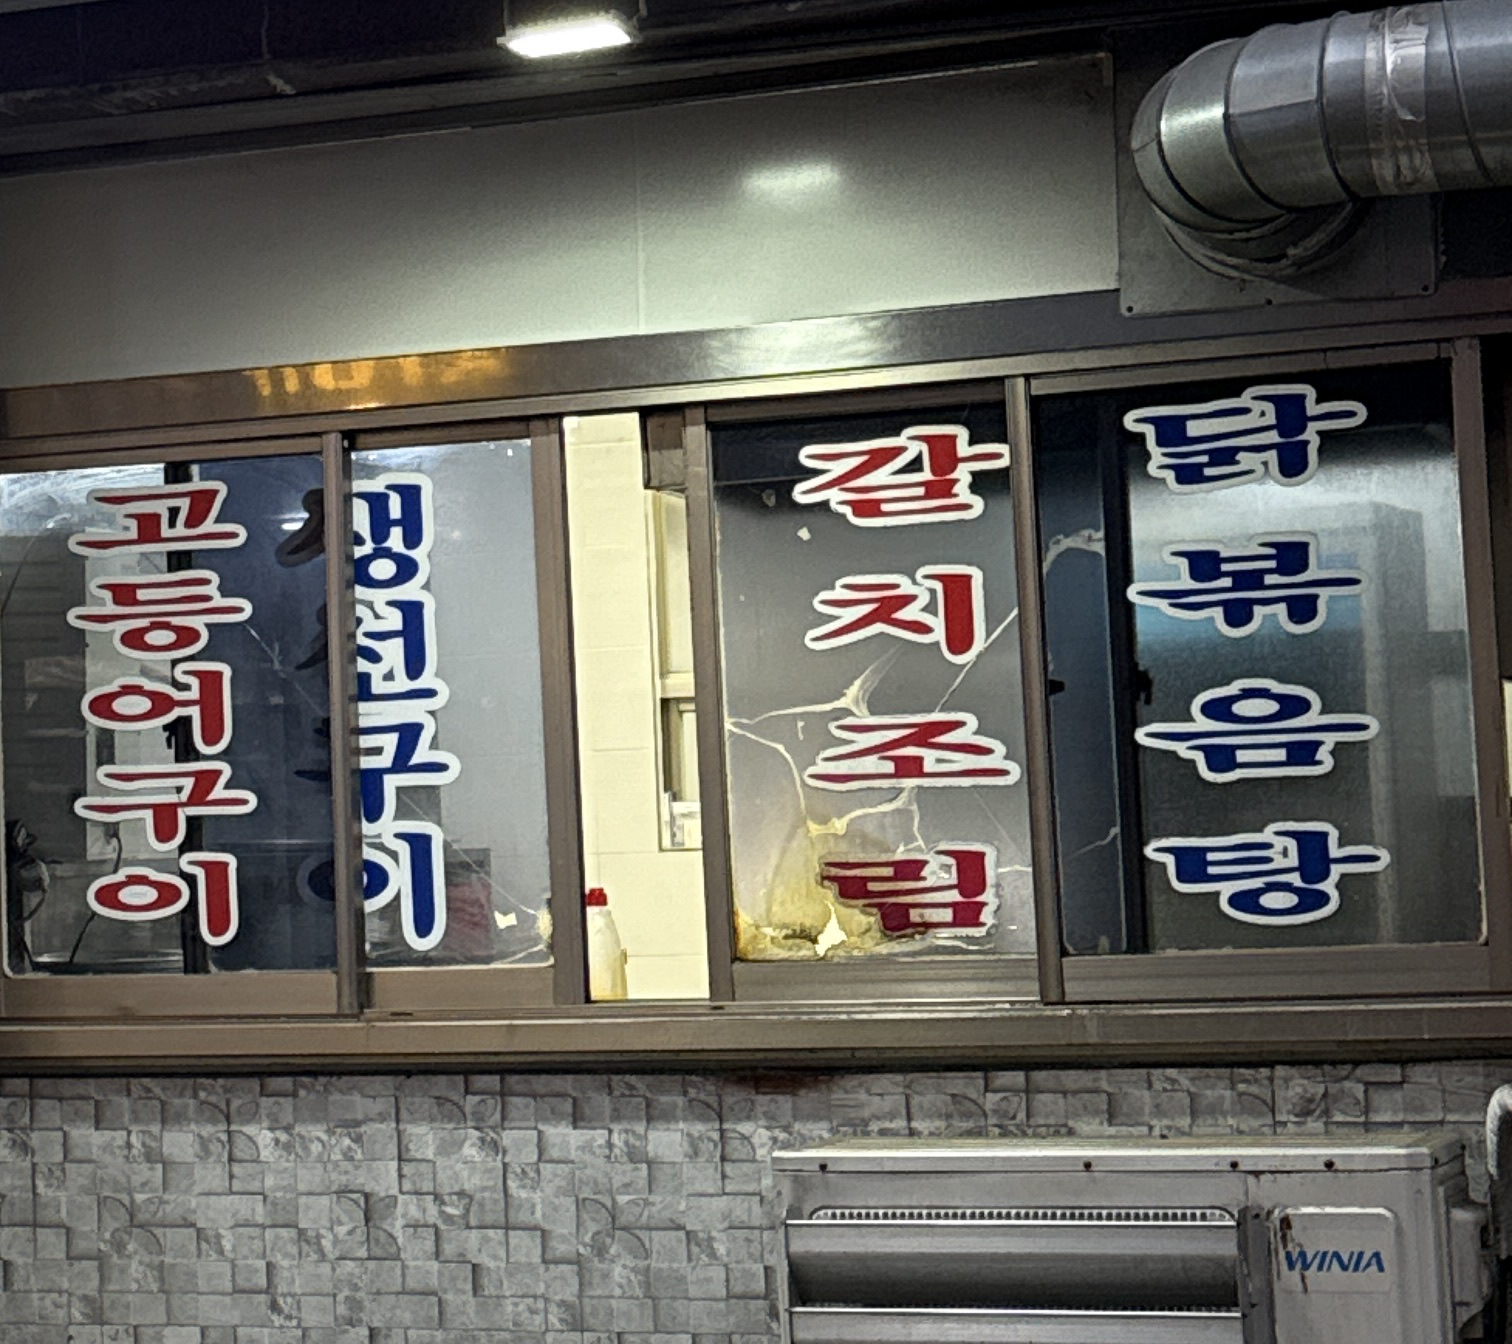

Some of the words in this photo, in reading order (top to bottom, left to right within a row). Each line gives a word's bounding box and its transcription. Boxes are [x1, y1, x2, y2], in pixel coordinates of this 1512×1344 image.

[72, 486, 253, 941] 고등어구이
[799, 431, 1012, 934] 갈치조림
[1130, 390, 1387, 918] 닭볶음탕
[1284, 1249, 1386, 1273] WINIA
